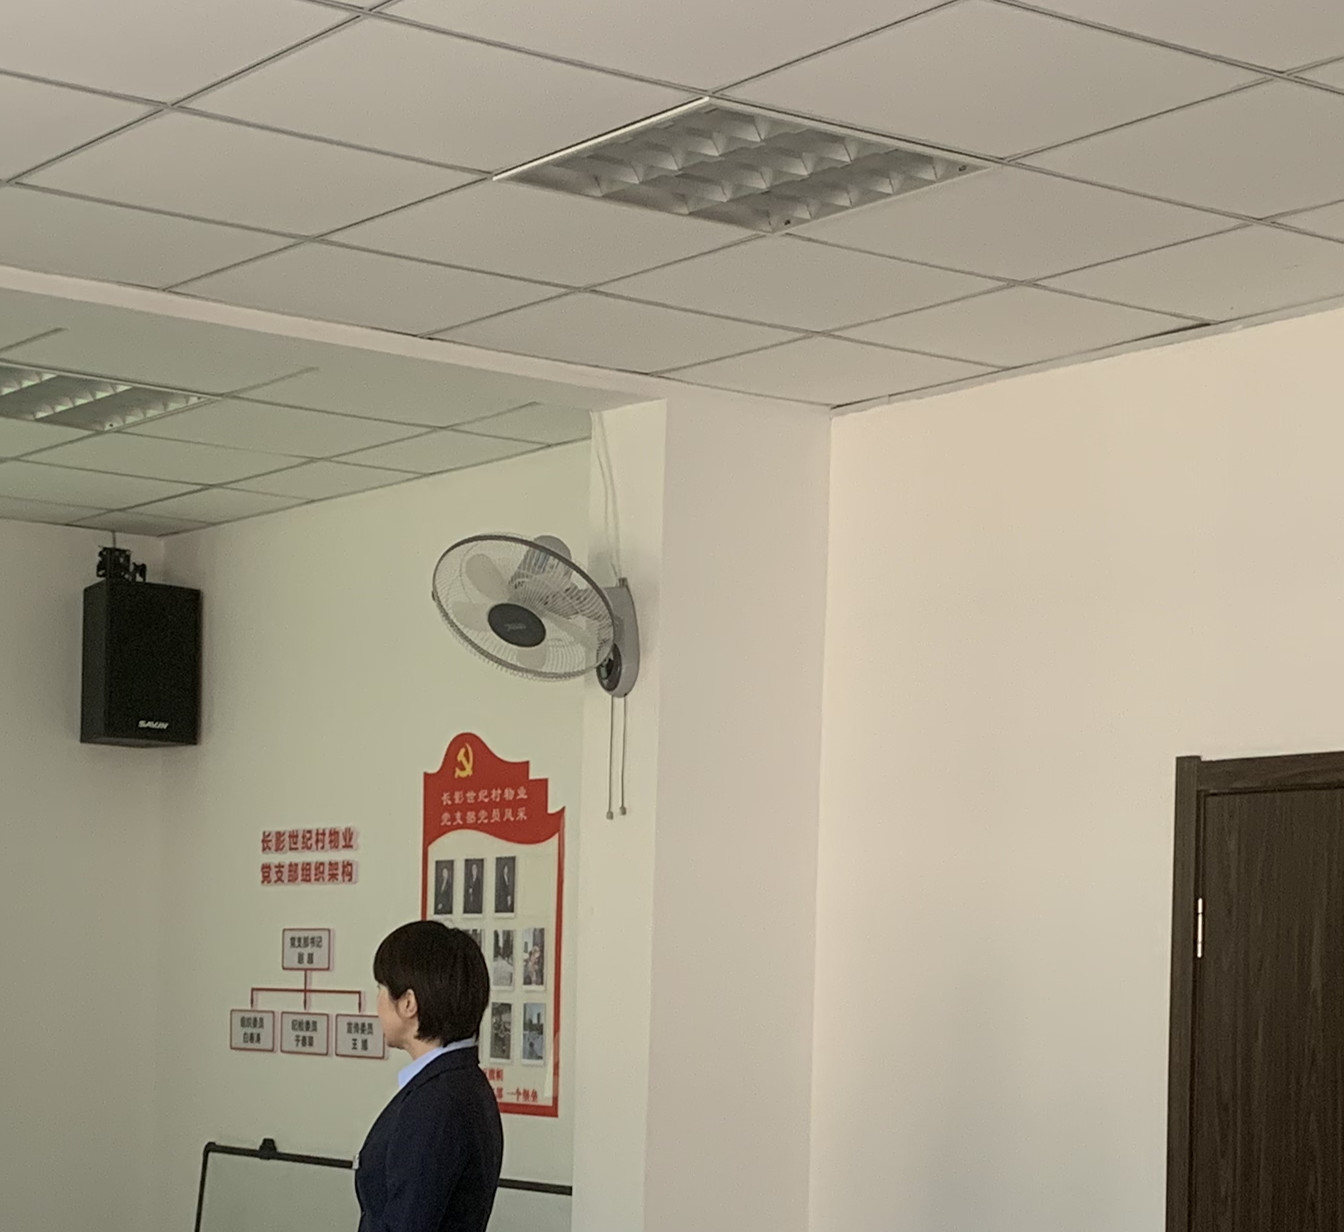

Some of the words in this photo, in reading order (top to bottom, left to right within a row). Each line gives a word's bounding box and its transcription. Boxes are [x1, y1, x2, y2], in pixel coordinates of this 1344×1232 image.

[441, 786, 528, 806] 长影世纪村物业
[261, 827, 353, 853] 长影世纪村物业
[260, 860, 353, 884] 党支部组织架构
